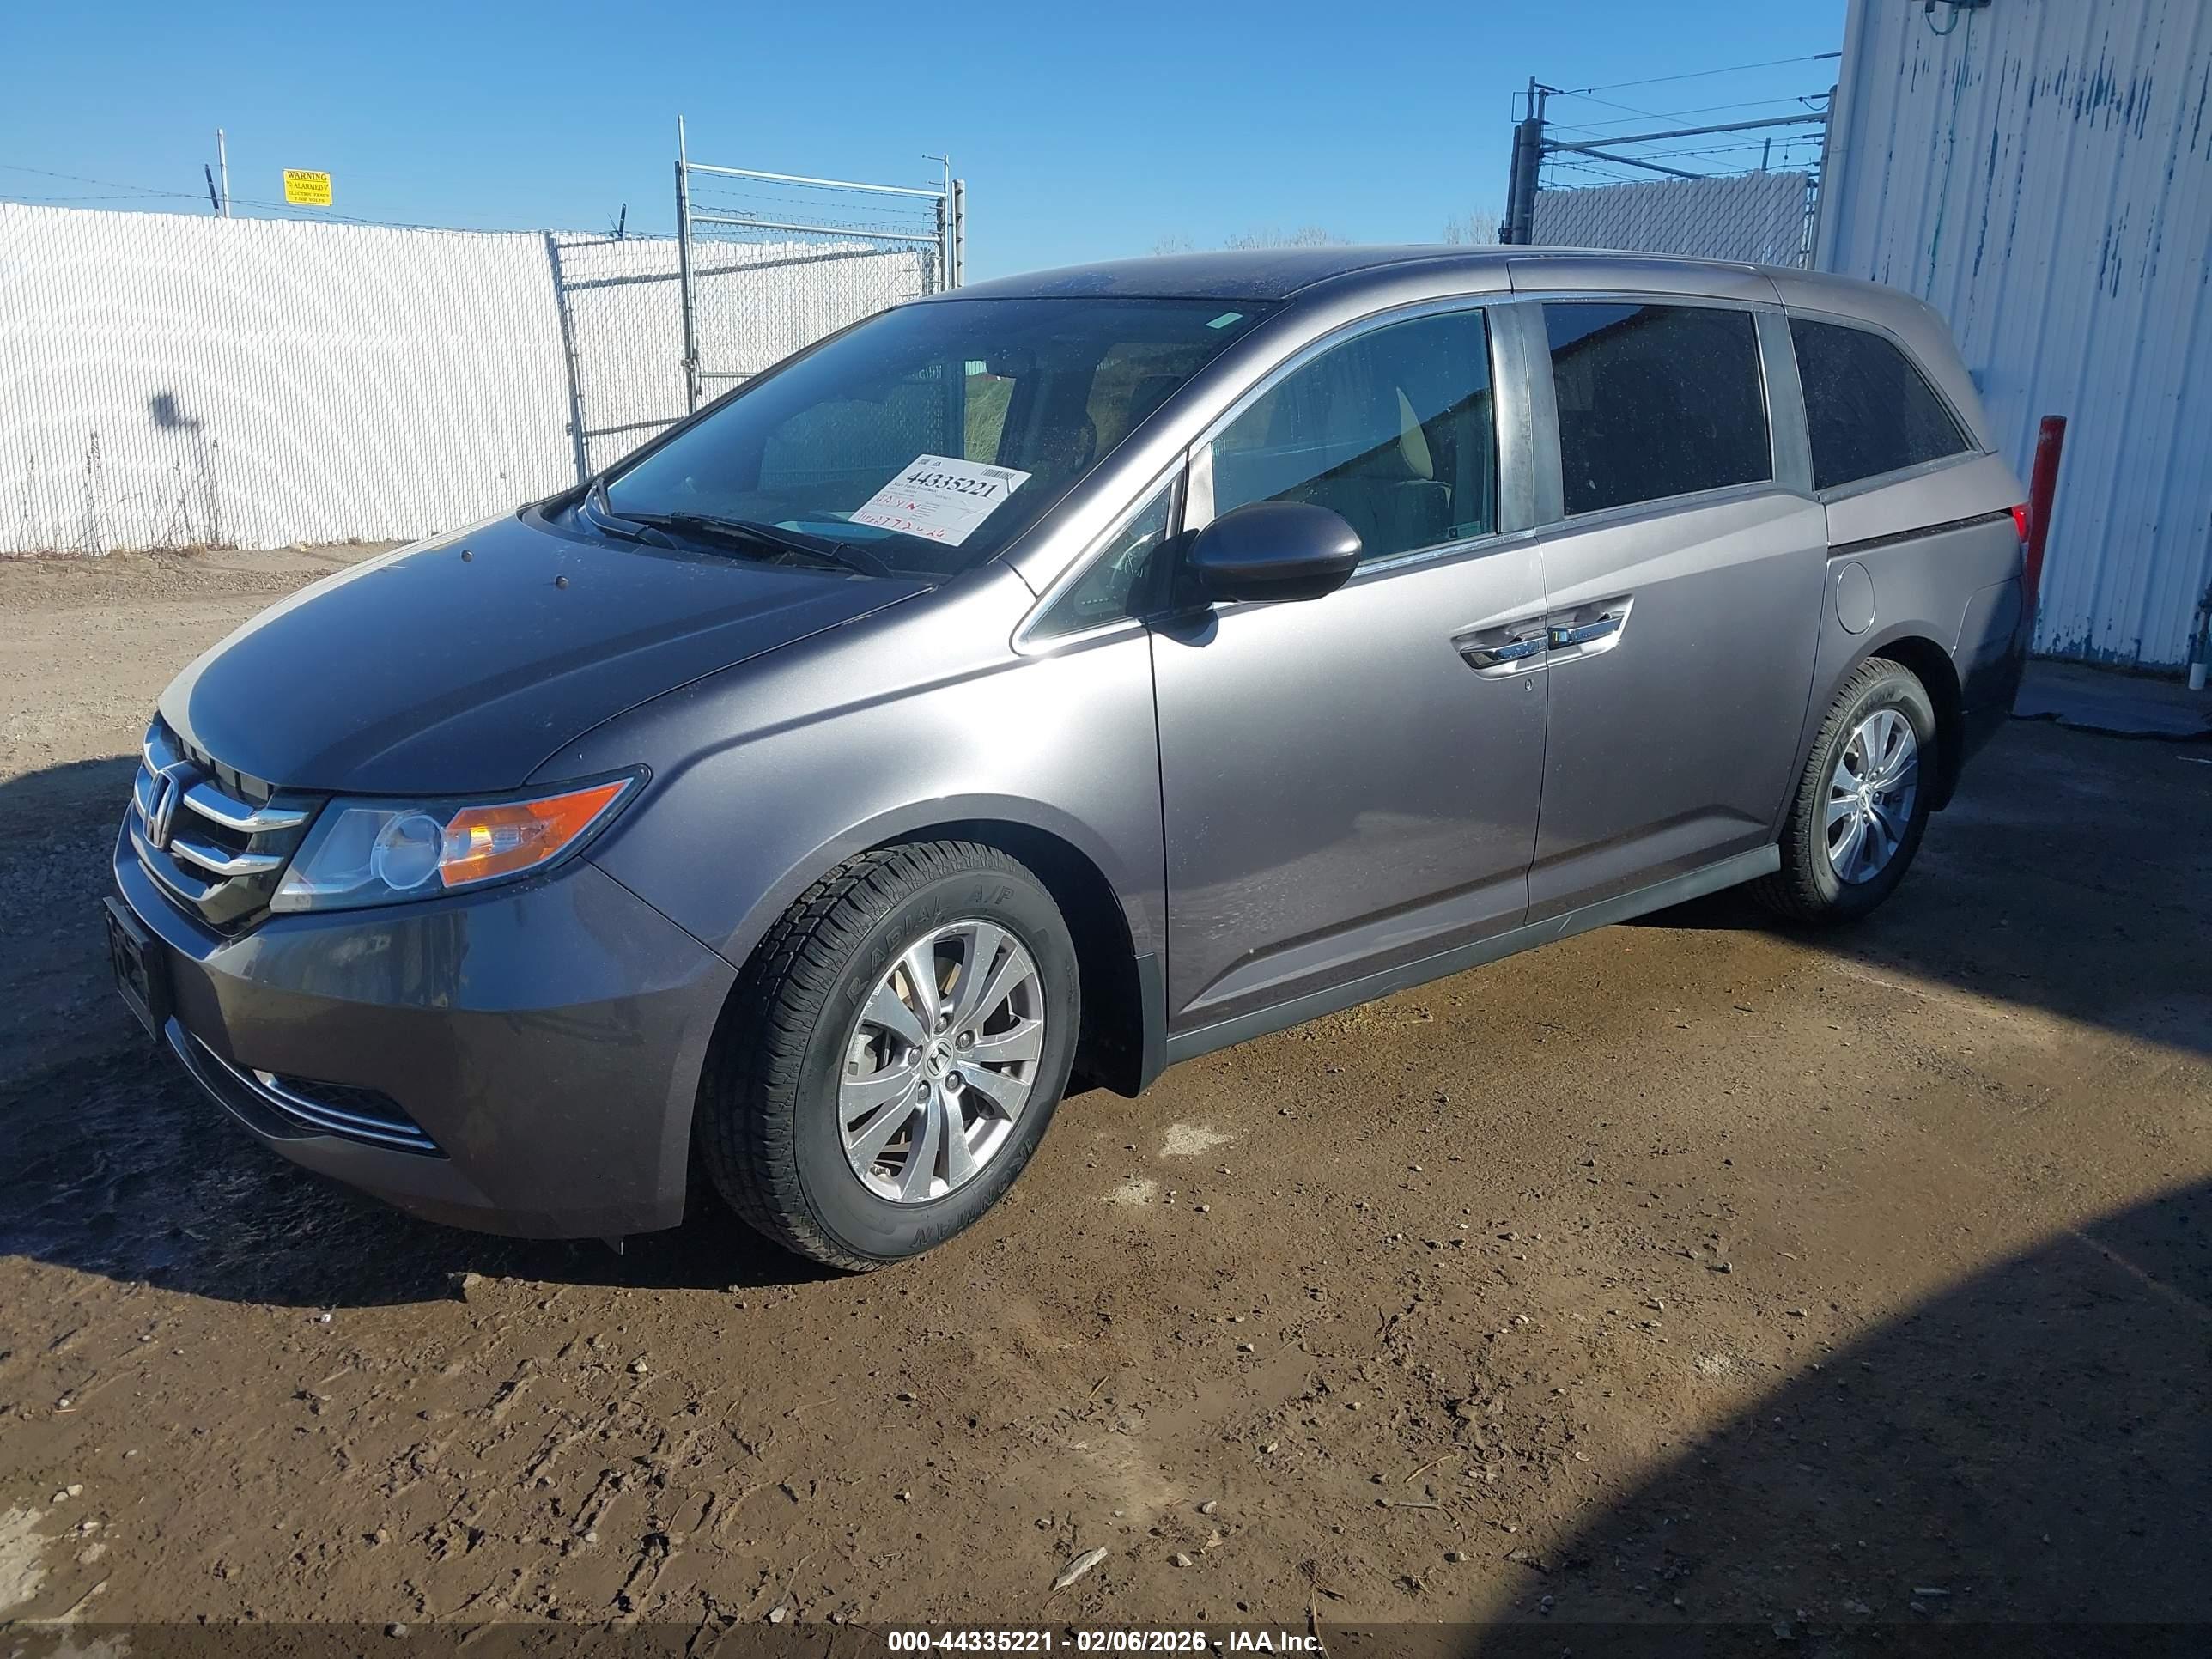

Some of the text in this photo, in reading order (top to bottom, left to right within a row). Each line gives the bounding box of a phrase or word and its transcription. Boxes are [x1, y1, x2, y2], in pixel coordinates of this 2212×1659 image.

[288, 171, 327, 180] WARNING
[906, 471, 999, 498] 44335221
[845, 884, 1015, 1006] RADIAL A/P
